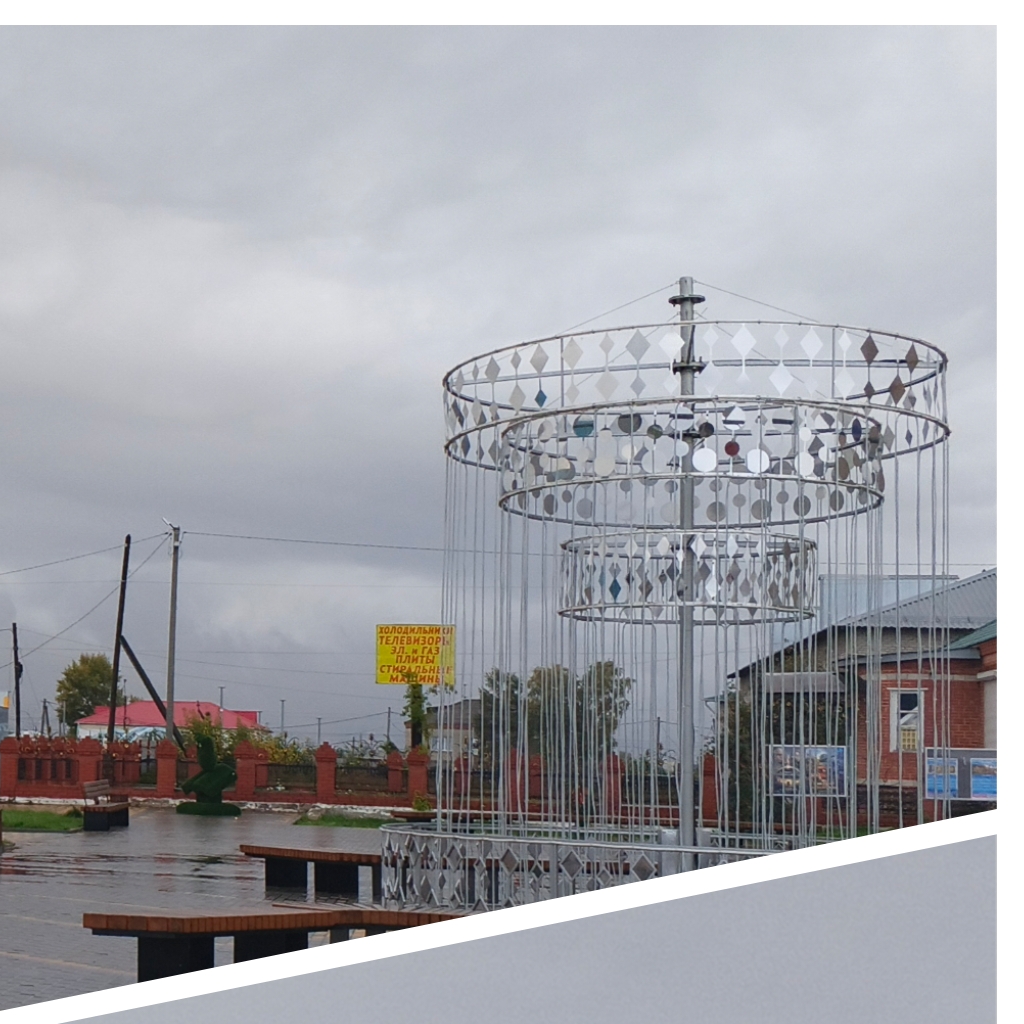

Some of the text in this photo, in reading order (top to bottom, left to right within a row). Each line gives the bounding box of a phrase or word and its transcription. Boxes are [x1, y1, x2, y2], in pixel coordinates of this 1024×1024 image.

[422, 646, 440, 655] ГАЗ
[395, 655, 436, 664] ПЛИТЫ
[389, 674, 444, 685] МАИНЫ
